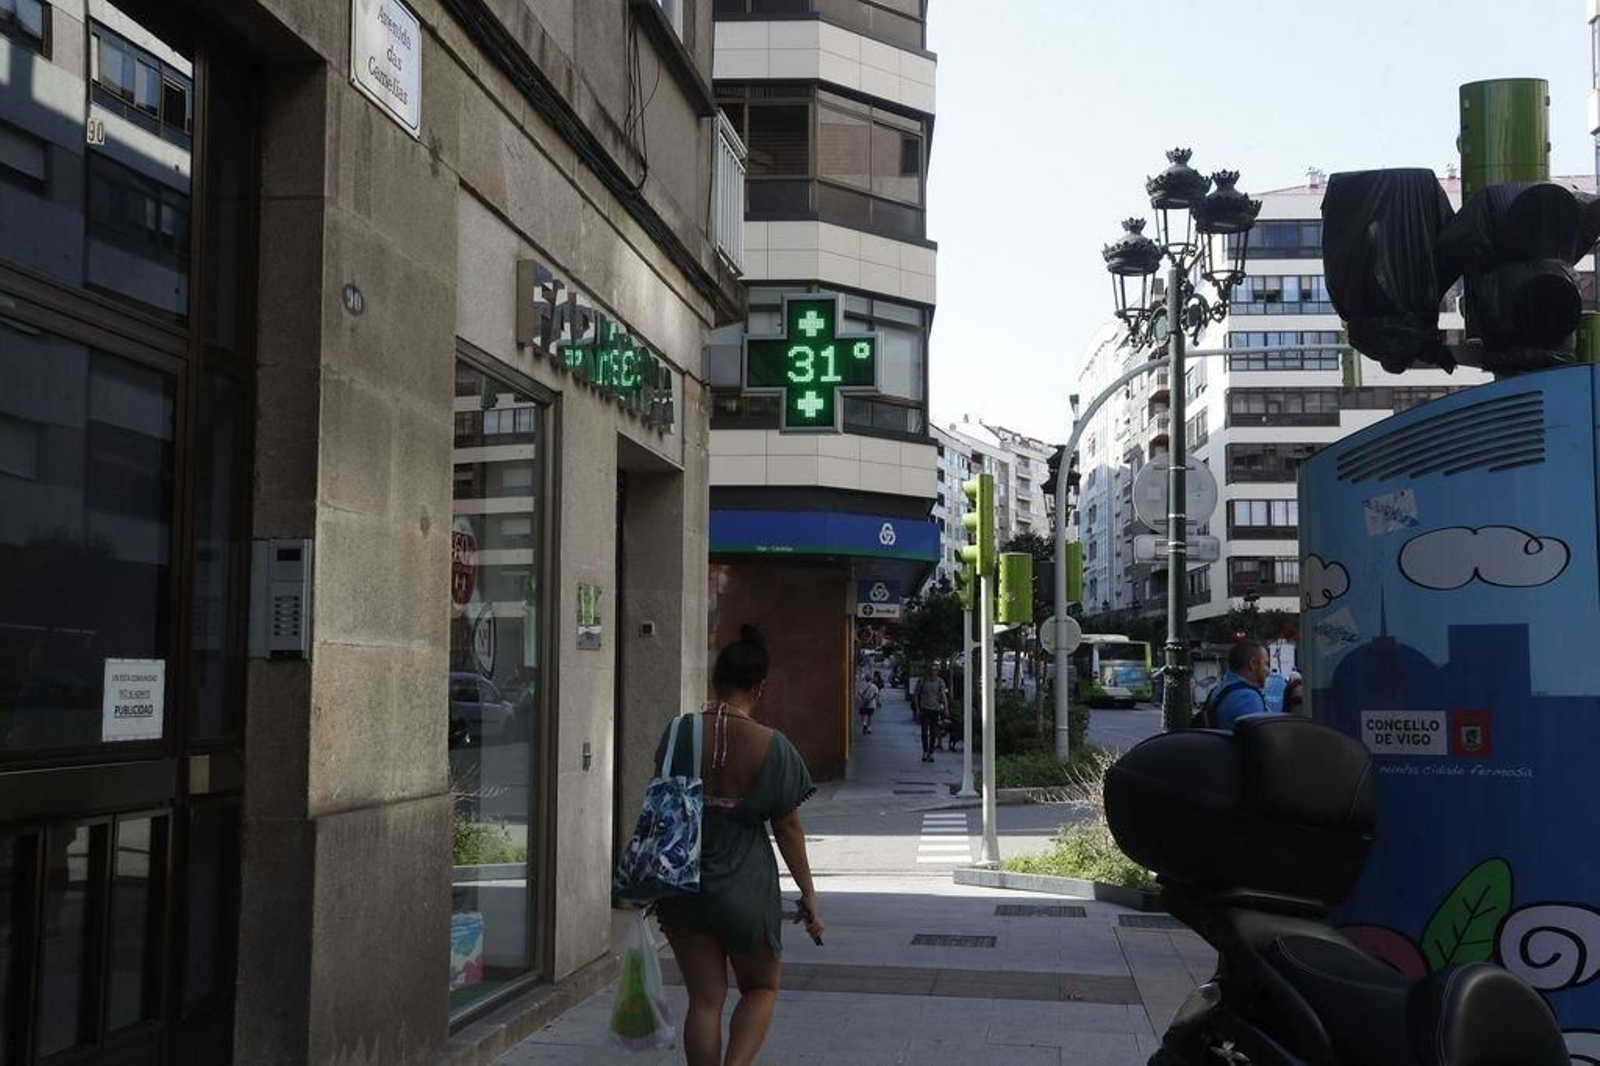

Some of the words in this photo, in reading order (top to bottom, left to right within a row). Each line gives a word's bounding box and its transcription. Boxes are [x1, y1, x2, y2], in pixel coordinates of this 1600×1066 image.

[377, 5, 412, 51] Avenida
[387, 44, 402, 71] das
[368, 55, 409, 105] Camelias
[88, 120, 104, 143] 90
[787, 341, 871, 382] 31°
[114, 704, 154, 716] PUBLICIDAD
[1366, 719, 1441, 733] CONCELLO
[1375, 733, 1392, 746] DE
[1397, 733, 1432, 746] VIGO
[1422, 763, 1464, 777] cidade
[1469, 763, 1534, 779] fermosa
